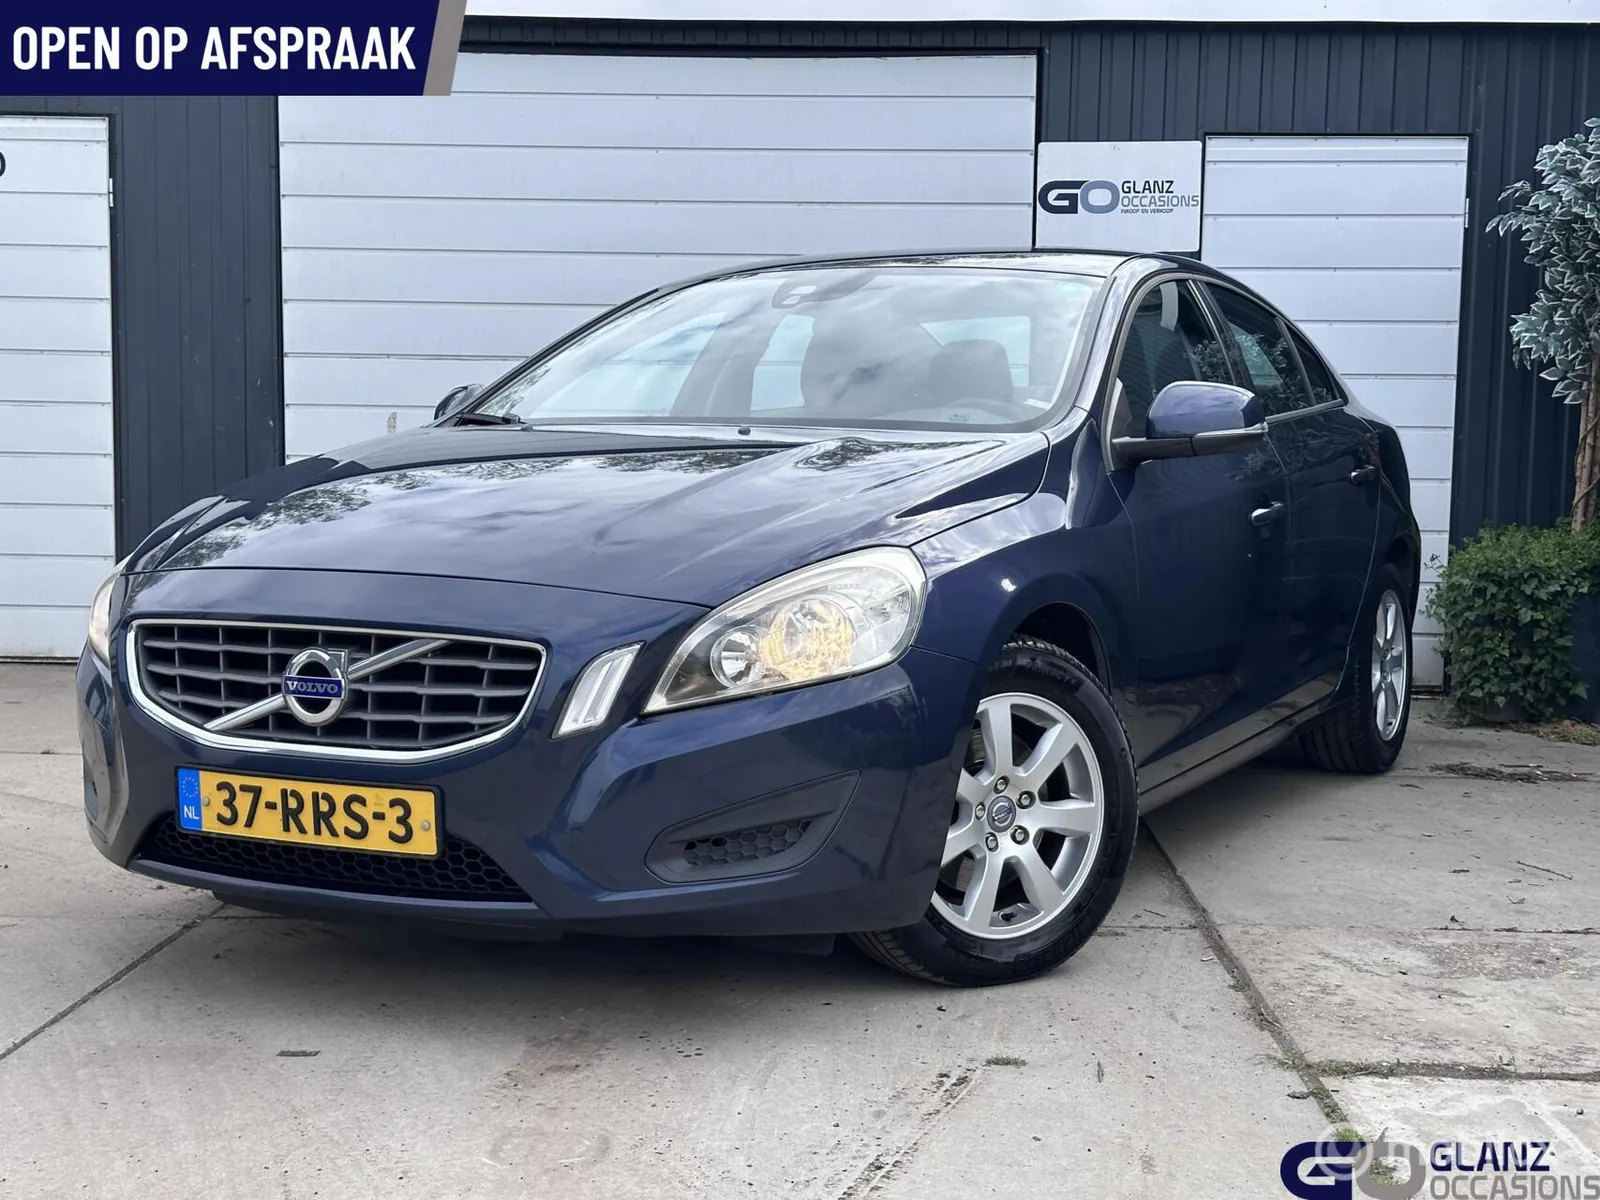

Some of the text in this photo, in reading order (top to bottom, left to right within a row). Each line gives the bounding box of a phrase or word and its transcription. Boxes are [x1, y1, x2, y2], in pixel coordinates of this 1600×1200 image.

[1121, 180, 1174, 194] GLANZ
[1038, 180, 1120, 214] GO
[1121, 195, 1199, 207] OCCASIONS
[286, 680, 339, 694] VOLVO
[184, 805, 199, 820] NL
[216, 781, 413, 844] 37-RRS-3
